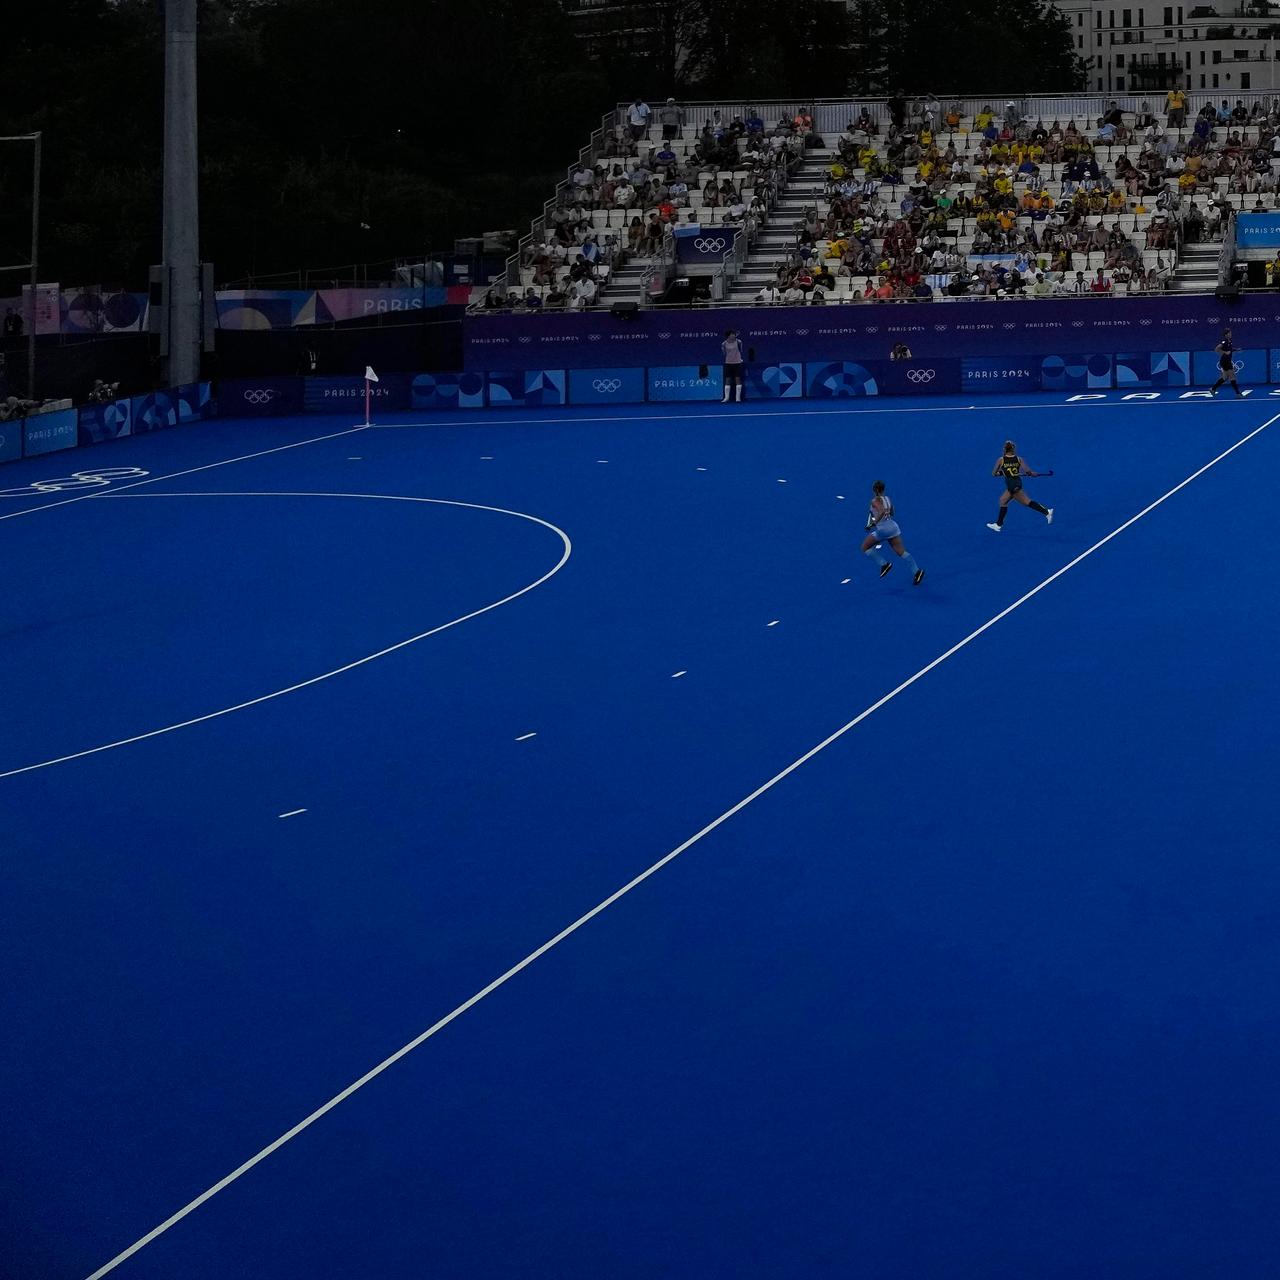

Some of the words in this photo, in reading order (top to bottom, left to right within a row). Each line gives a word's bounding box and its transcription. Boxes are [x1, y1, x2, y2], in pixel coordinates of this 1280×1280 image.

[364, 298, 423, 313] PARIS
[968, 371, 998, 379] PARIS
[1002, 369, 1030, 377] 2024
[654, 379, 686, 388] PARIS
[689, 379, 717, 387] 2024
[324, 389, 356, 397] PARIS
[28, 429, 51, 441] PARIS
[53, 425, 74, 436] 2024
